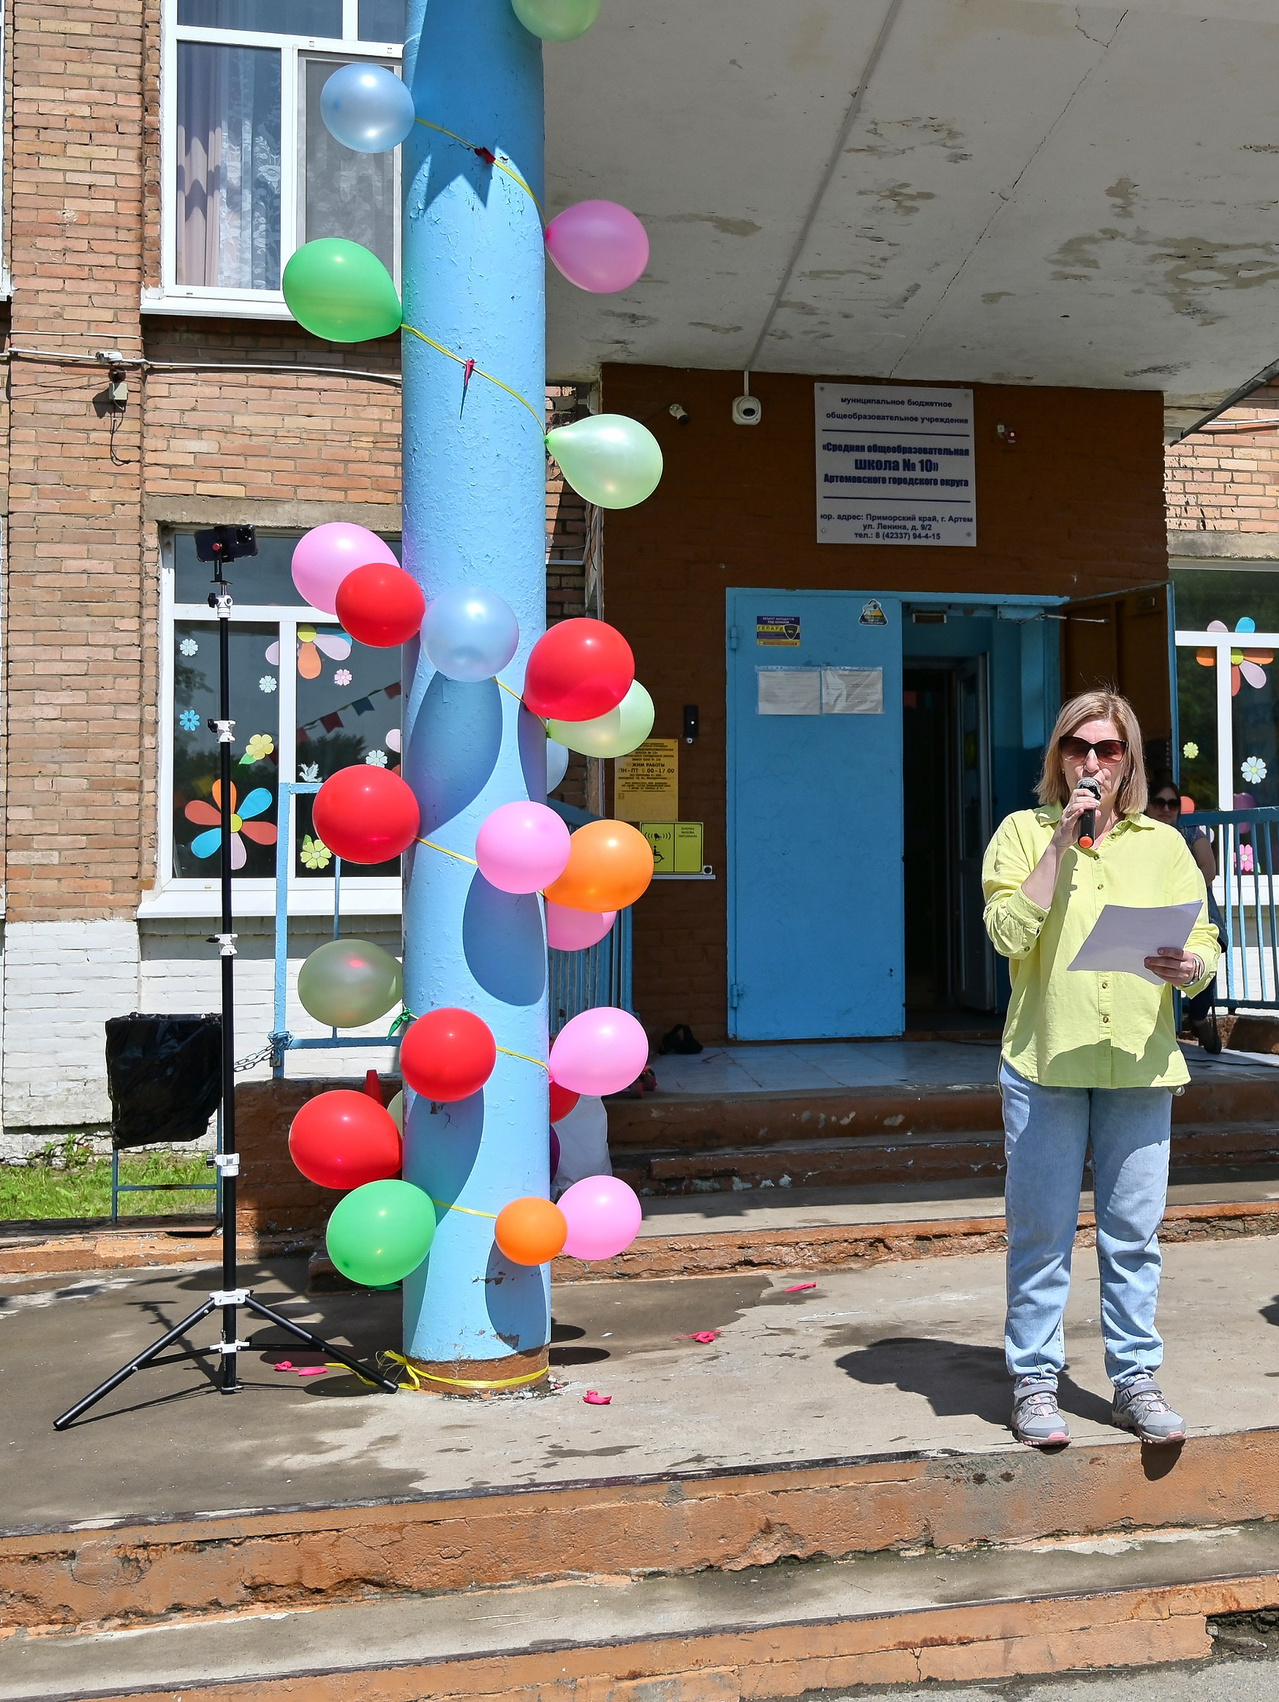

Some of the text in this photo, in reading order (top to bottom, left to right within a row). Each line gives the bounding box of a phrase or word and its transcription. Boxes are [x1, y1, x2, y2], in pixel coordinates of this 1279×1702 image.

[840, 397, 953, 408] муниципальное бюджетное
[825, 412, 969, 425] общеобразовательное учреждение
[822, 442, 970, 456] «Средняя общеобразовательная
[902, 459, 916, 472] №
[918, 459, 939, 473] 10»
[823, 473, 969, 488] Артемовского городского округа
[820, 513, 835, 522] юр.
[836, 514, 864, 523] адрес:
[866, 513, 916, 523] Приморский
[918, 514, 939, 523] край,
[947, 515, 973, 524] Артем
[862, 523, 933, 532] ул. Ленина, д. 9/2
[854, 531, 941, 541] тел.: 8 (42337) 94-4-15
